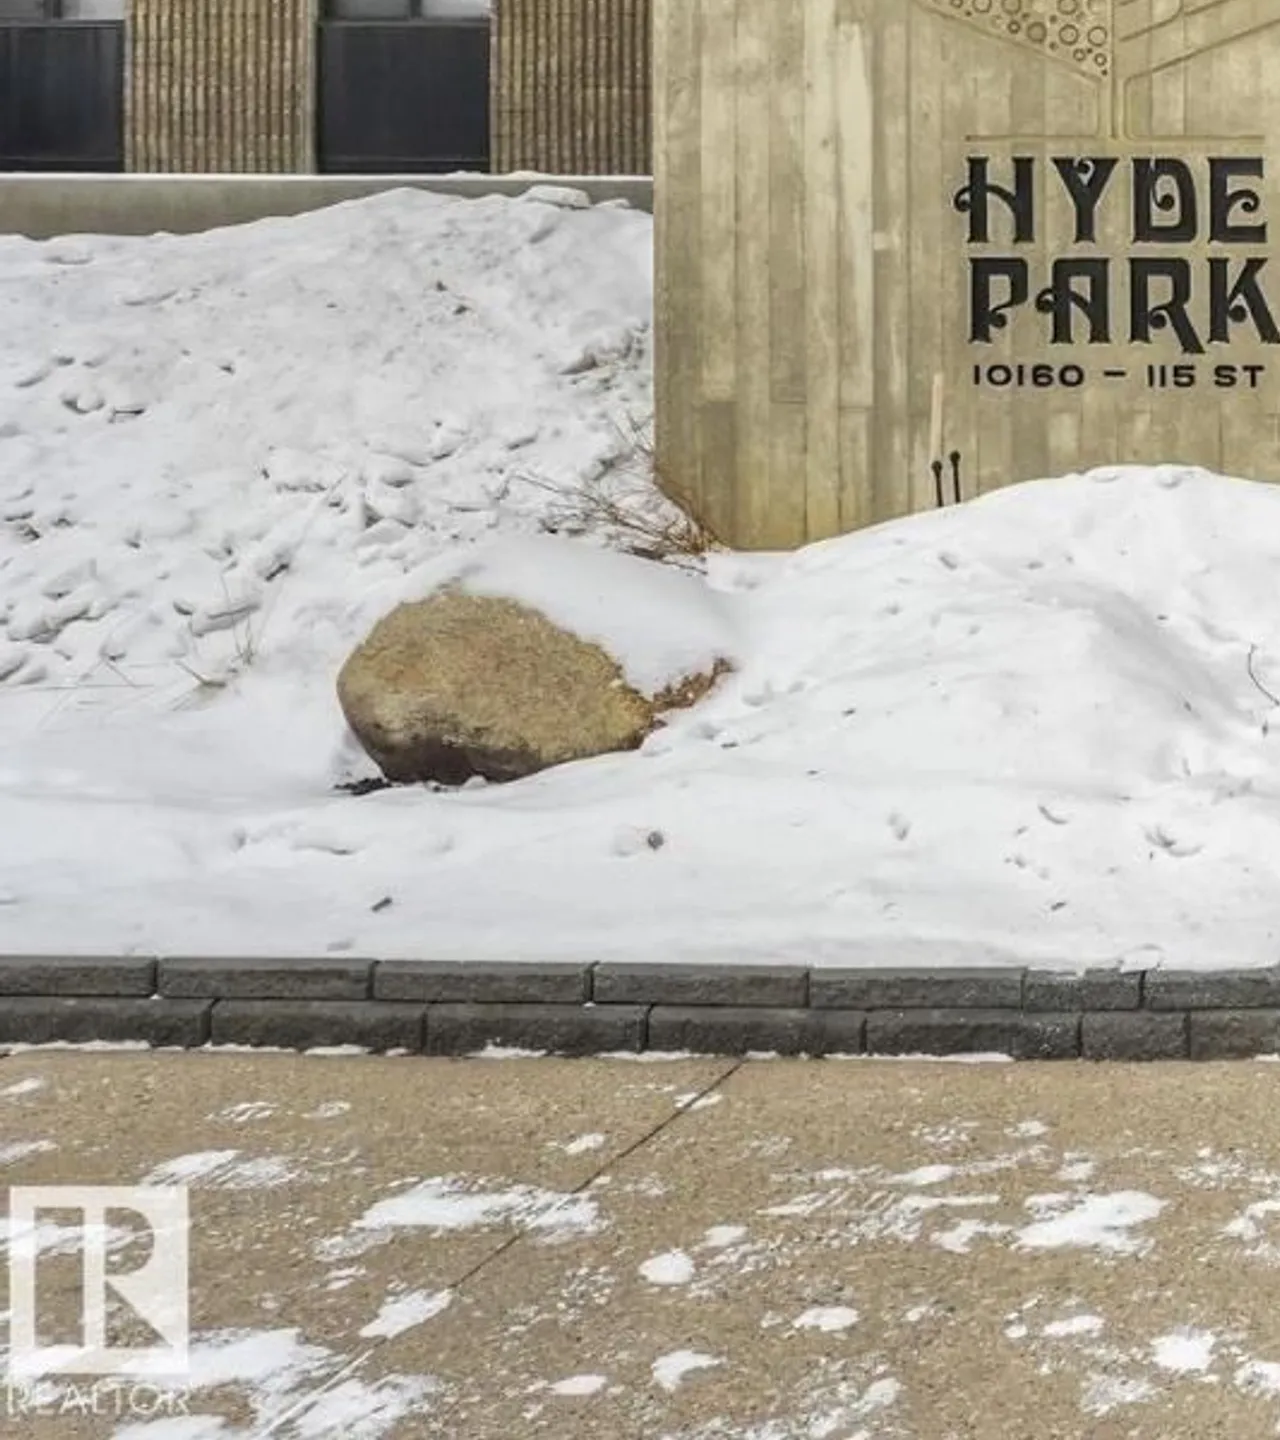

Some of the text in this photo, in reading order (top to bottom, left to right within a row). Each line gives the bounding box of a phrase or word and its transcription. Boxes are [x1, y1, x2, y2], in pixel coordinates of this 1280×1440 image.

[954, 156, 1269, 245] HYDE
[973, 363, 1086, 389] 10160
[1147, 363, 1197, 389] 115
[1213, 363, 1266, 389] ST
